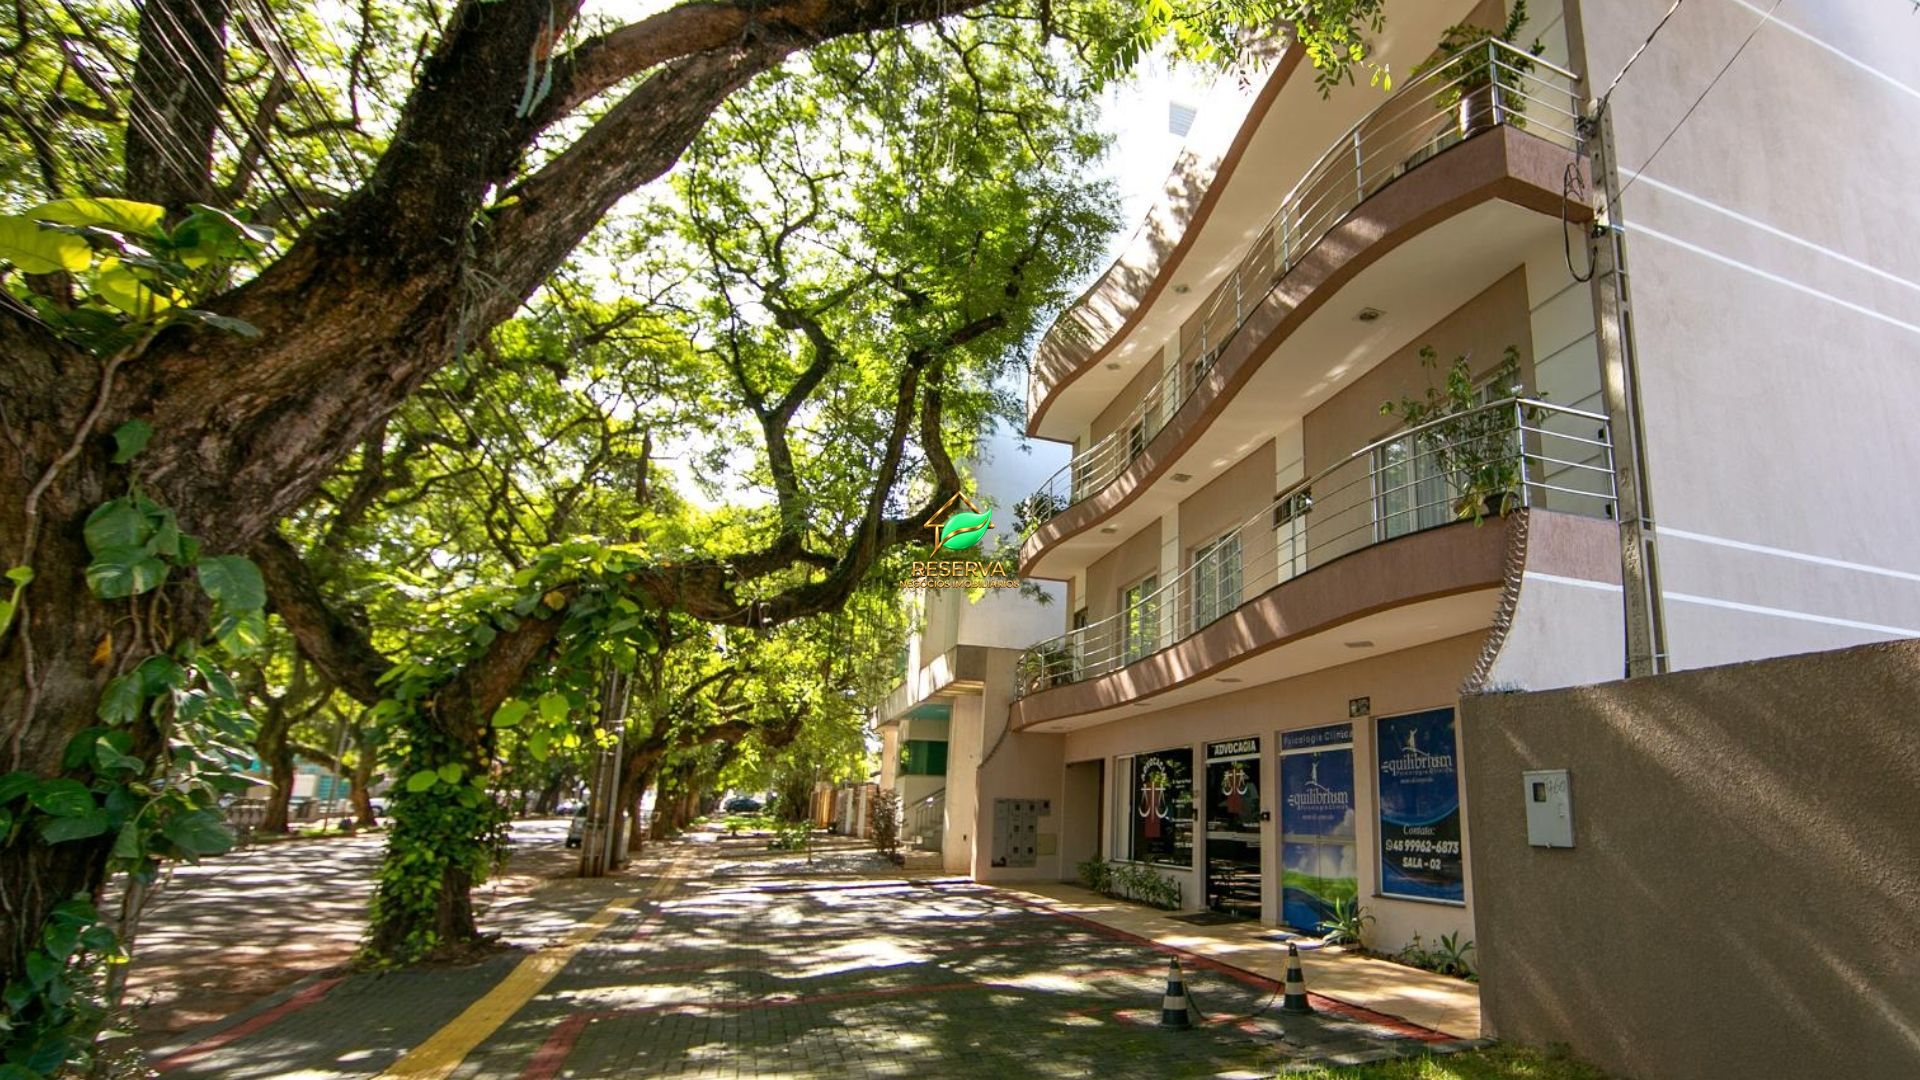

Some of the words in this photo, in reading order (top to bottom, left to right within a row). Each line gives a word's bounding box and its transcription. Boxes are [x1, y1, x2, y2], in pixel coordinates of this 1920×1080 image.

[1214, 740, 1256, 756] ADVOCACIA
[1393, 839, 1403, 851] 45
[1404, 839, 1460, 854] 99962-6873
[1402, 857, 1423, 868] SALA
[1430, 858, 1441, 870] 02
